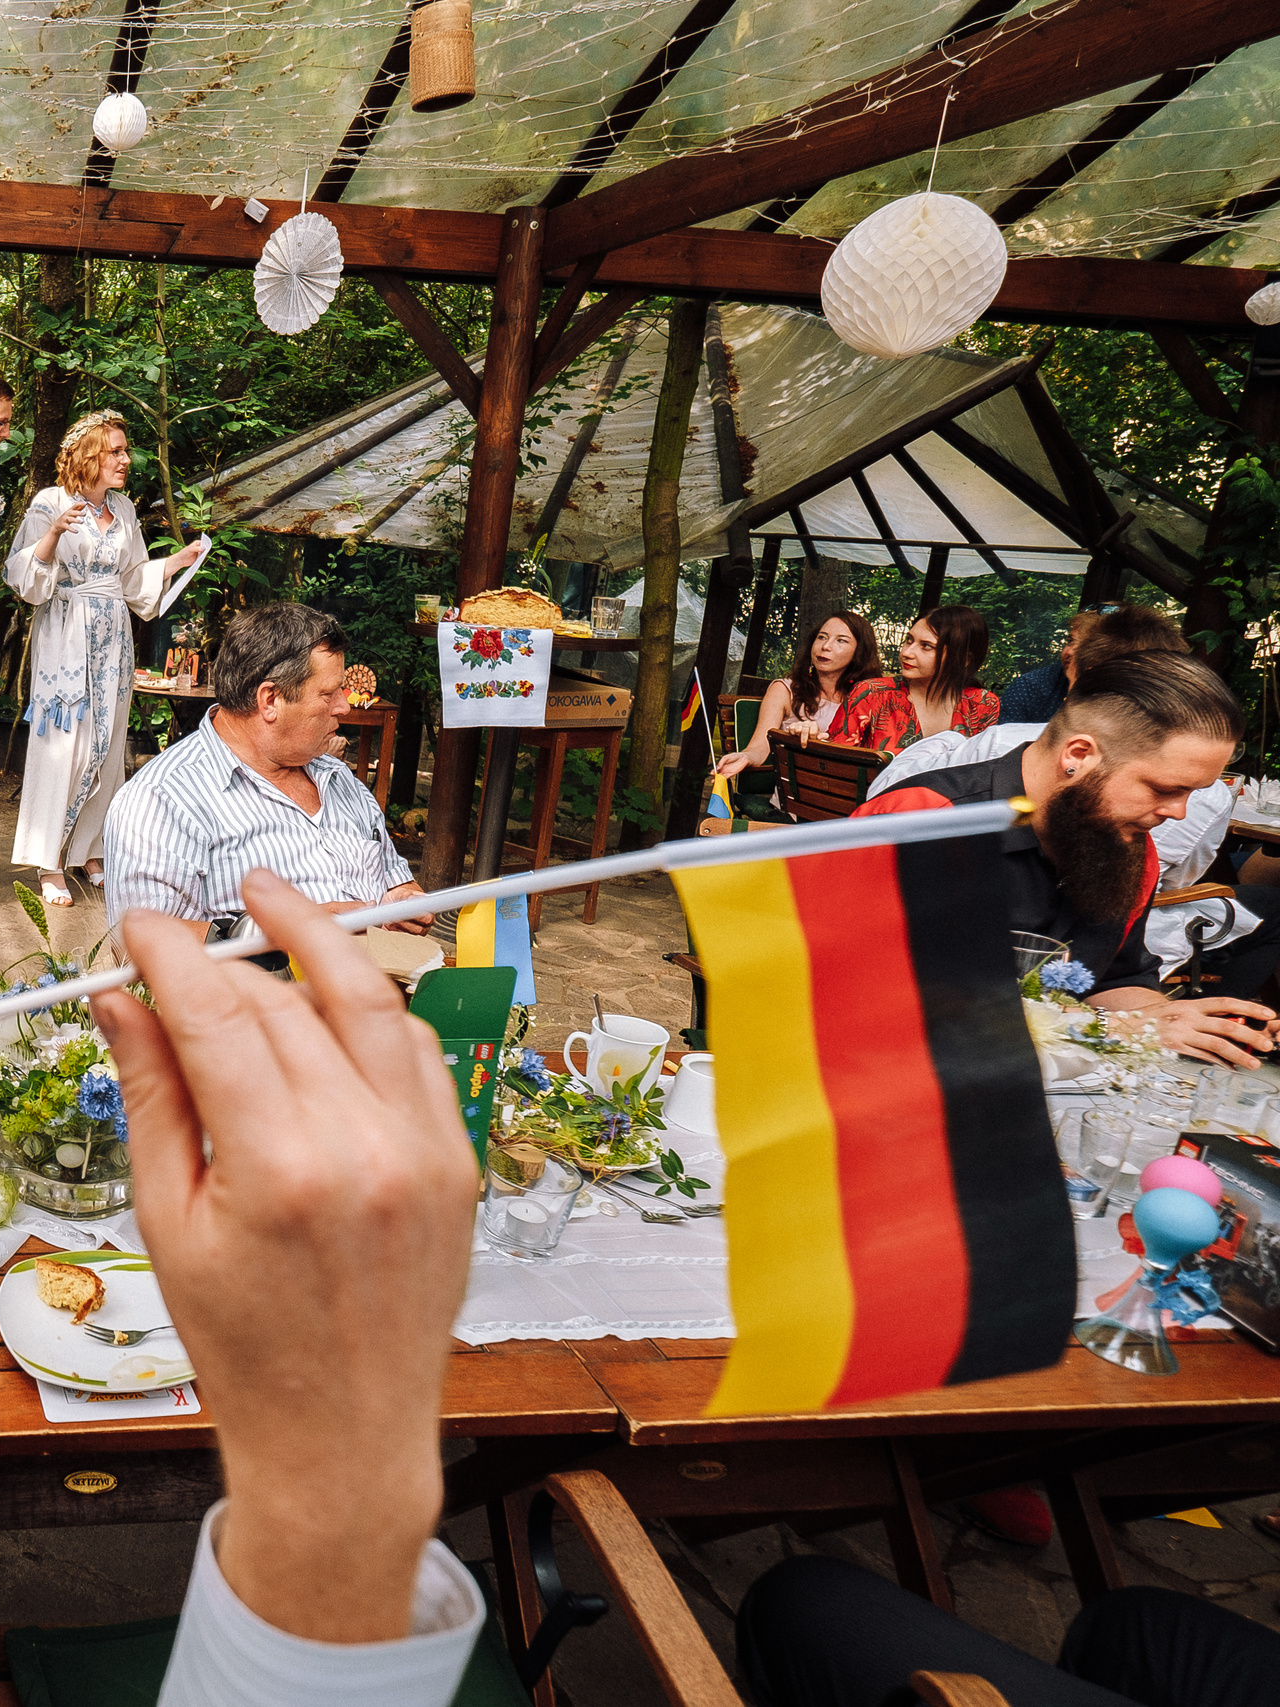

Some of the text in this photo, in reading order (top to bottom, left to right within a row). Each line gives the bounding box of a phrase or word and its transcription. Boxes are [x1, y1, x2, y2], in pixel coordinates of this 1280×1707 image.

[546, 695, 602, 707] OKOGAWA
[469, 1063, 487, 1098] duplo
[1207, 1161, 1267, 1201] TECHNIC
[167, 1386, 190, 1407] K
[71, 1477, 110, 1487] DAZZLERS
